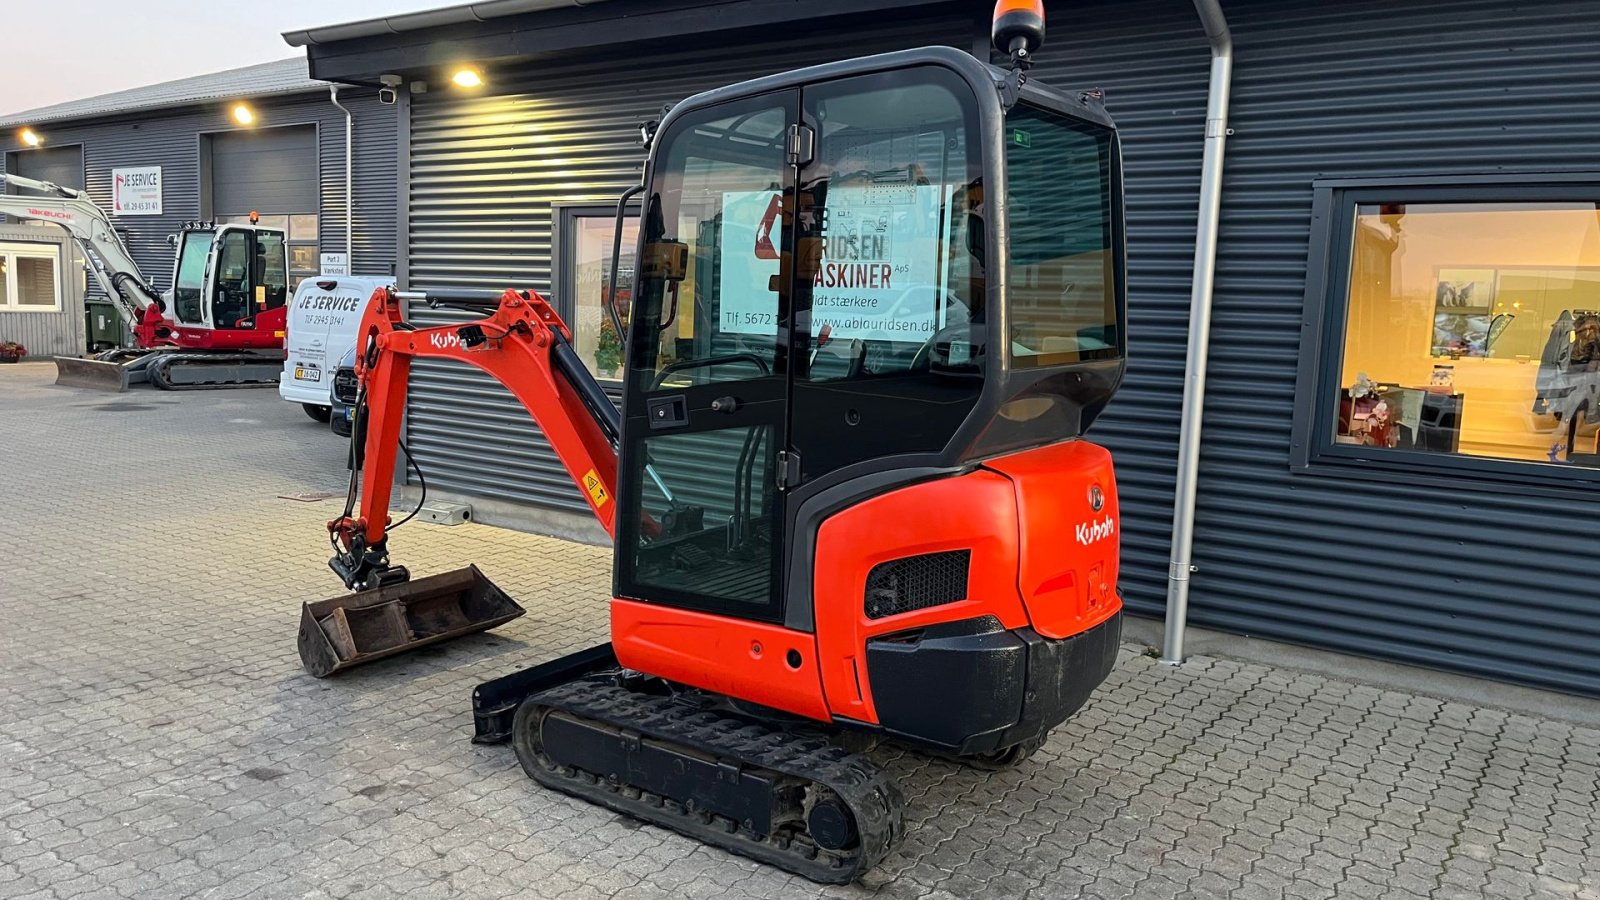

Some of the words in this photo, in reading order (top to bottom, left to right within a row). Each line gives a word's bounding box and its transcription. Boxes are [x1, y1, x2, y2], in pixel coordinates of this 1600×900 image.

[124, 174, 130, 187] JE
[131, 172, 157, 186] SERVICE
[814, 263, 892, 289] ASKINER
[894, 265, 909, 273] ApS
[300, 295, 313, 310] JE
[312, 295, 360, 312] SERVICE
[830, 296, 878, 308] stærkere
[726, 311, 742, 327] Tlf.
[744, 312, 772, 325] 5672
[297, 369, 304, 377] CT
[1075, 514, 1114, 546] Kubota
